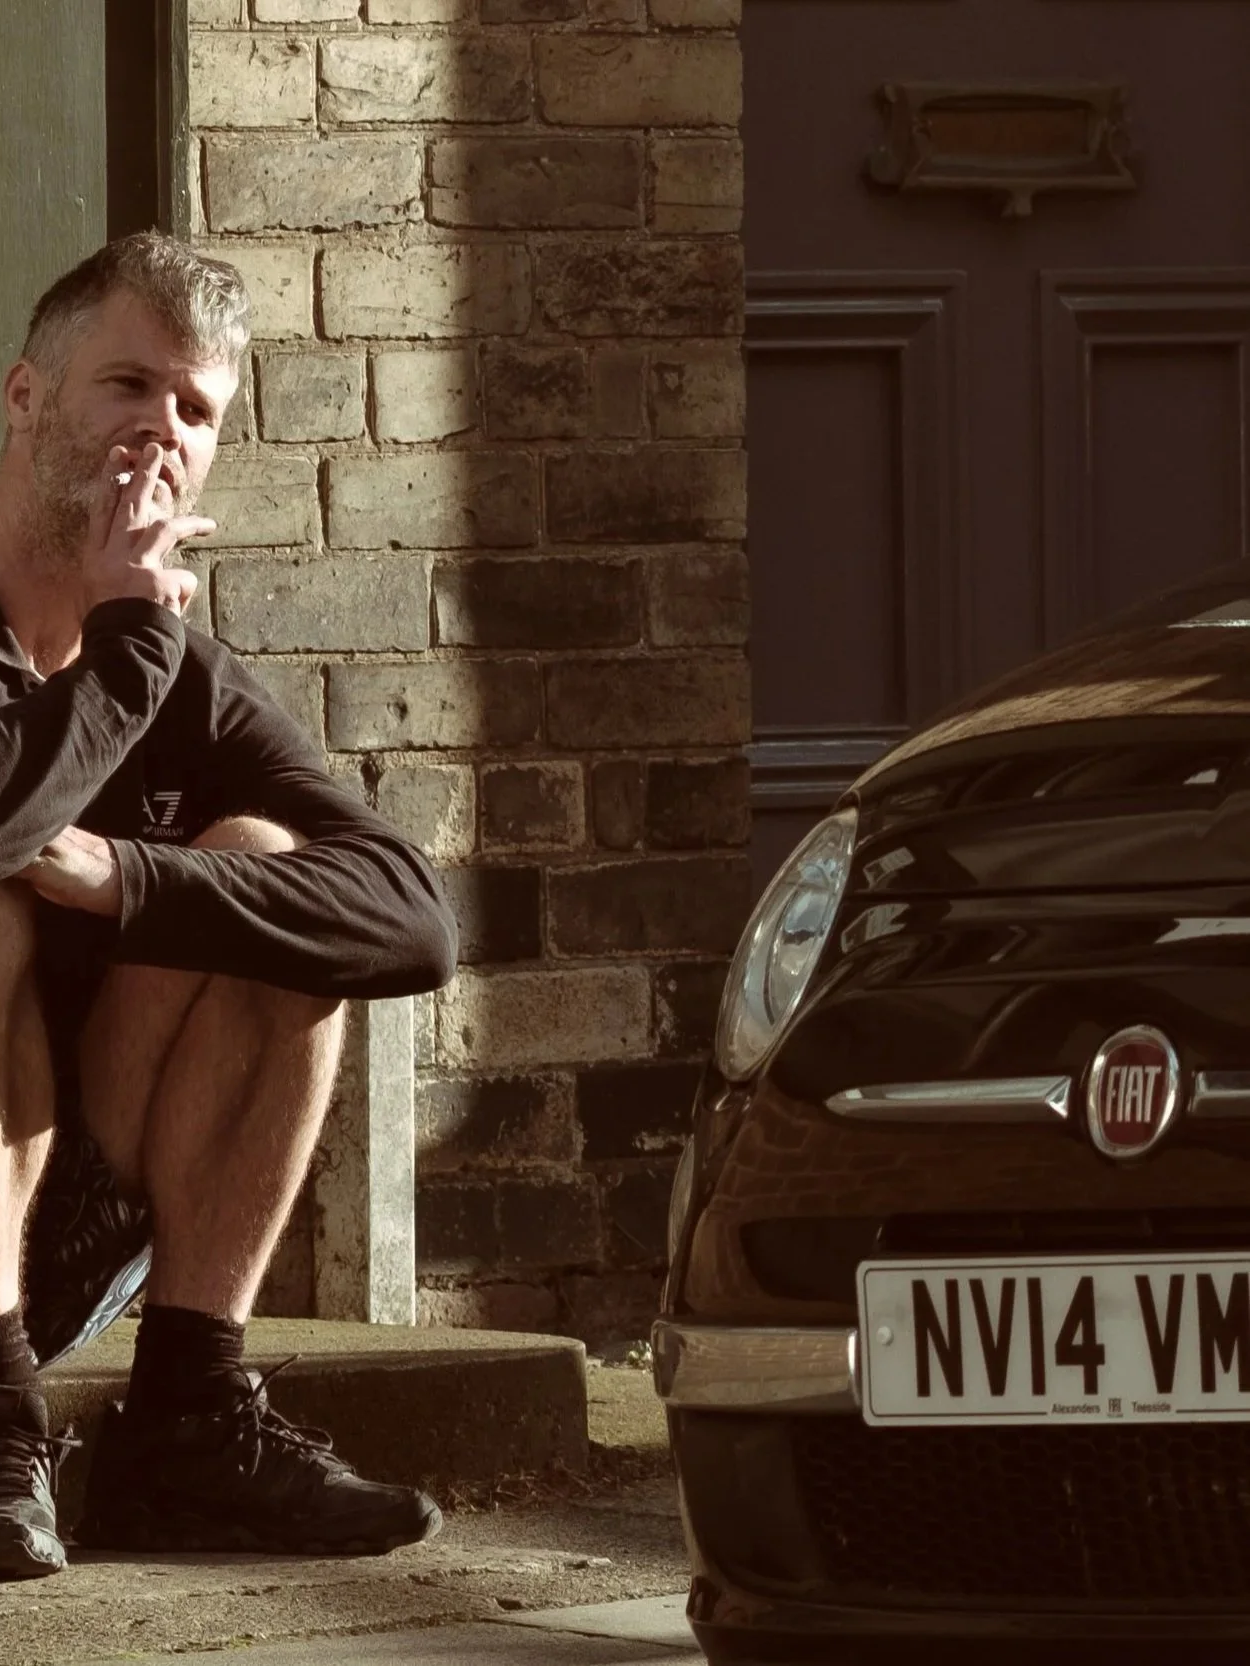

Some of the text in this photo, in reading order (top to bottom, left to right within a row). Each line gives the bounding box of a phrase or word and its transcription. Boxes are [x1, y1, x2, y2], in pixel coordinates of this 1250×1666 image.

[1105, 1065, 1163, 1124] FIAT
[911, 1271, 1250, 1398] NV14 VM
[1051, 1402, 1101, 1415] Alexanders
[1131, 1400, 1172, 1414] Teesside
